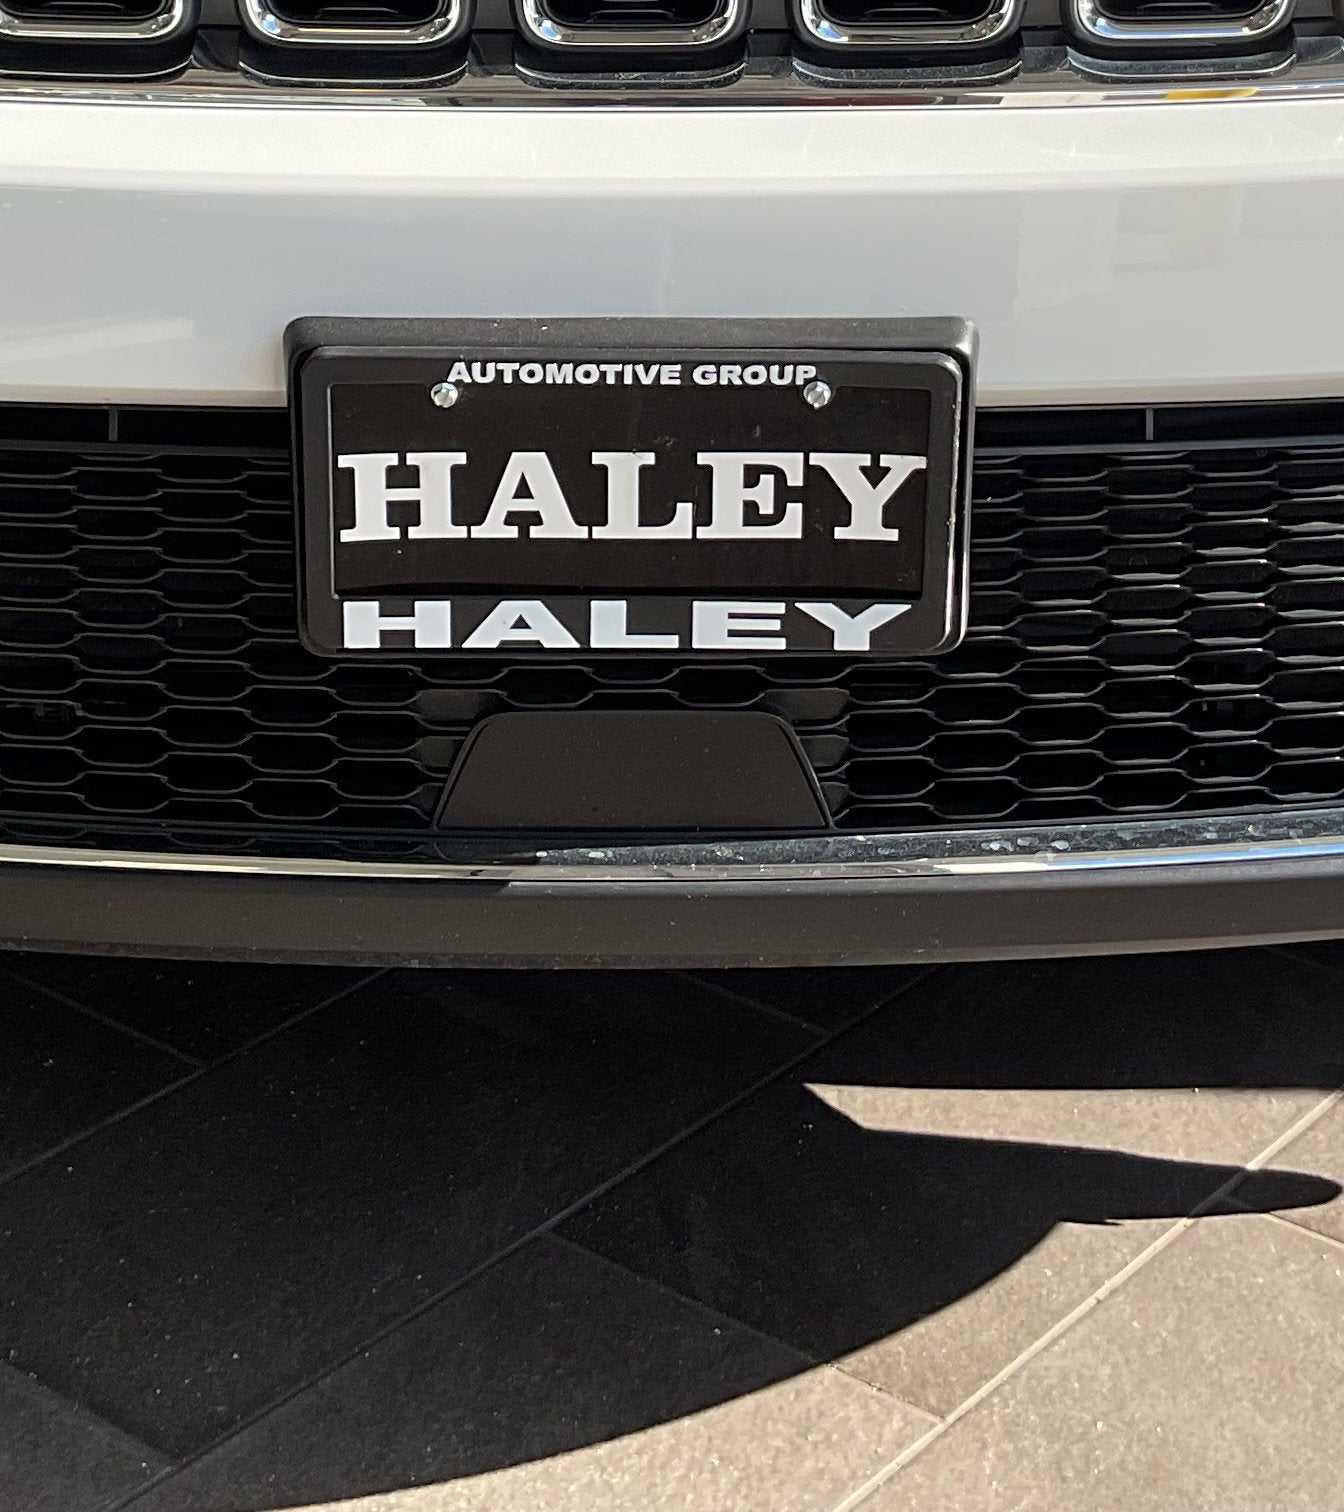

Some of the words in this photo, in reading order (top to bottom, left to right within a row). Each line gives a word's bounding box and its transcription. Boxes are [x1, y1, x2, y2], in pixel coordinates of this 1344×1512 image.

[447, 361, 681, 387] AUTOMOTIVE
[692, 363, 817, 387] GROUP
[337, 452, 927, 543] HALEY
[343, 600, 912, 651] HALEY
